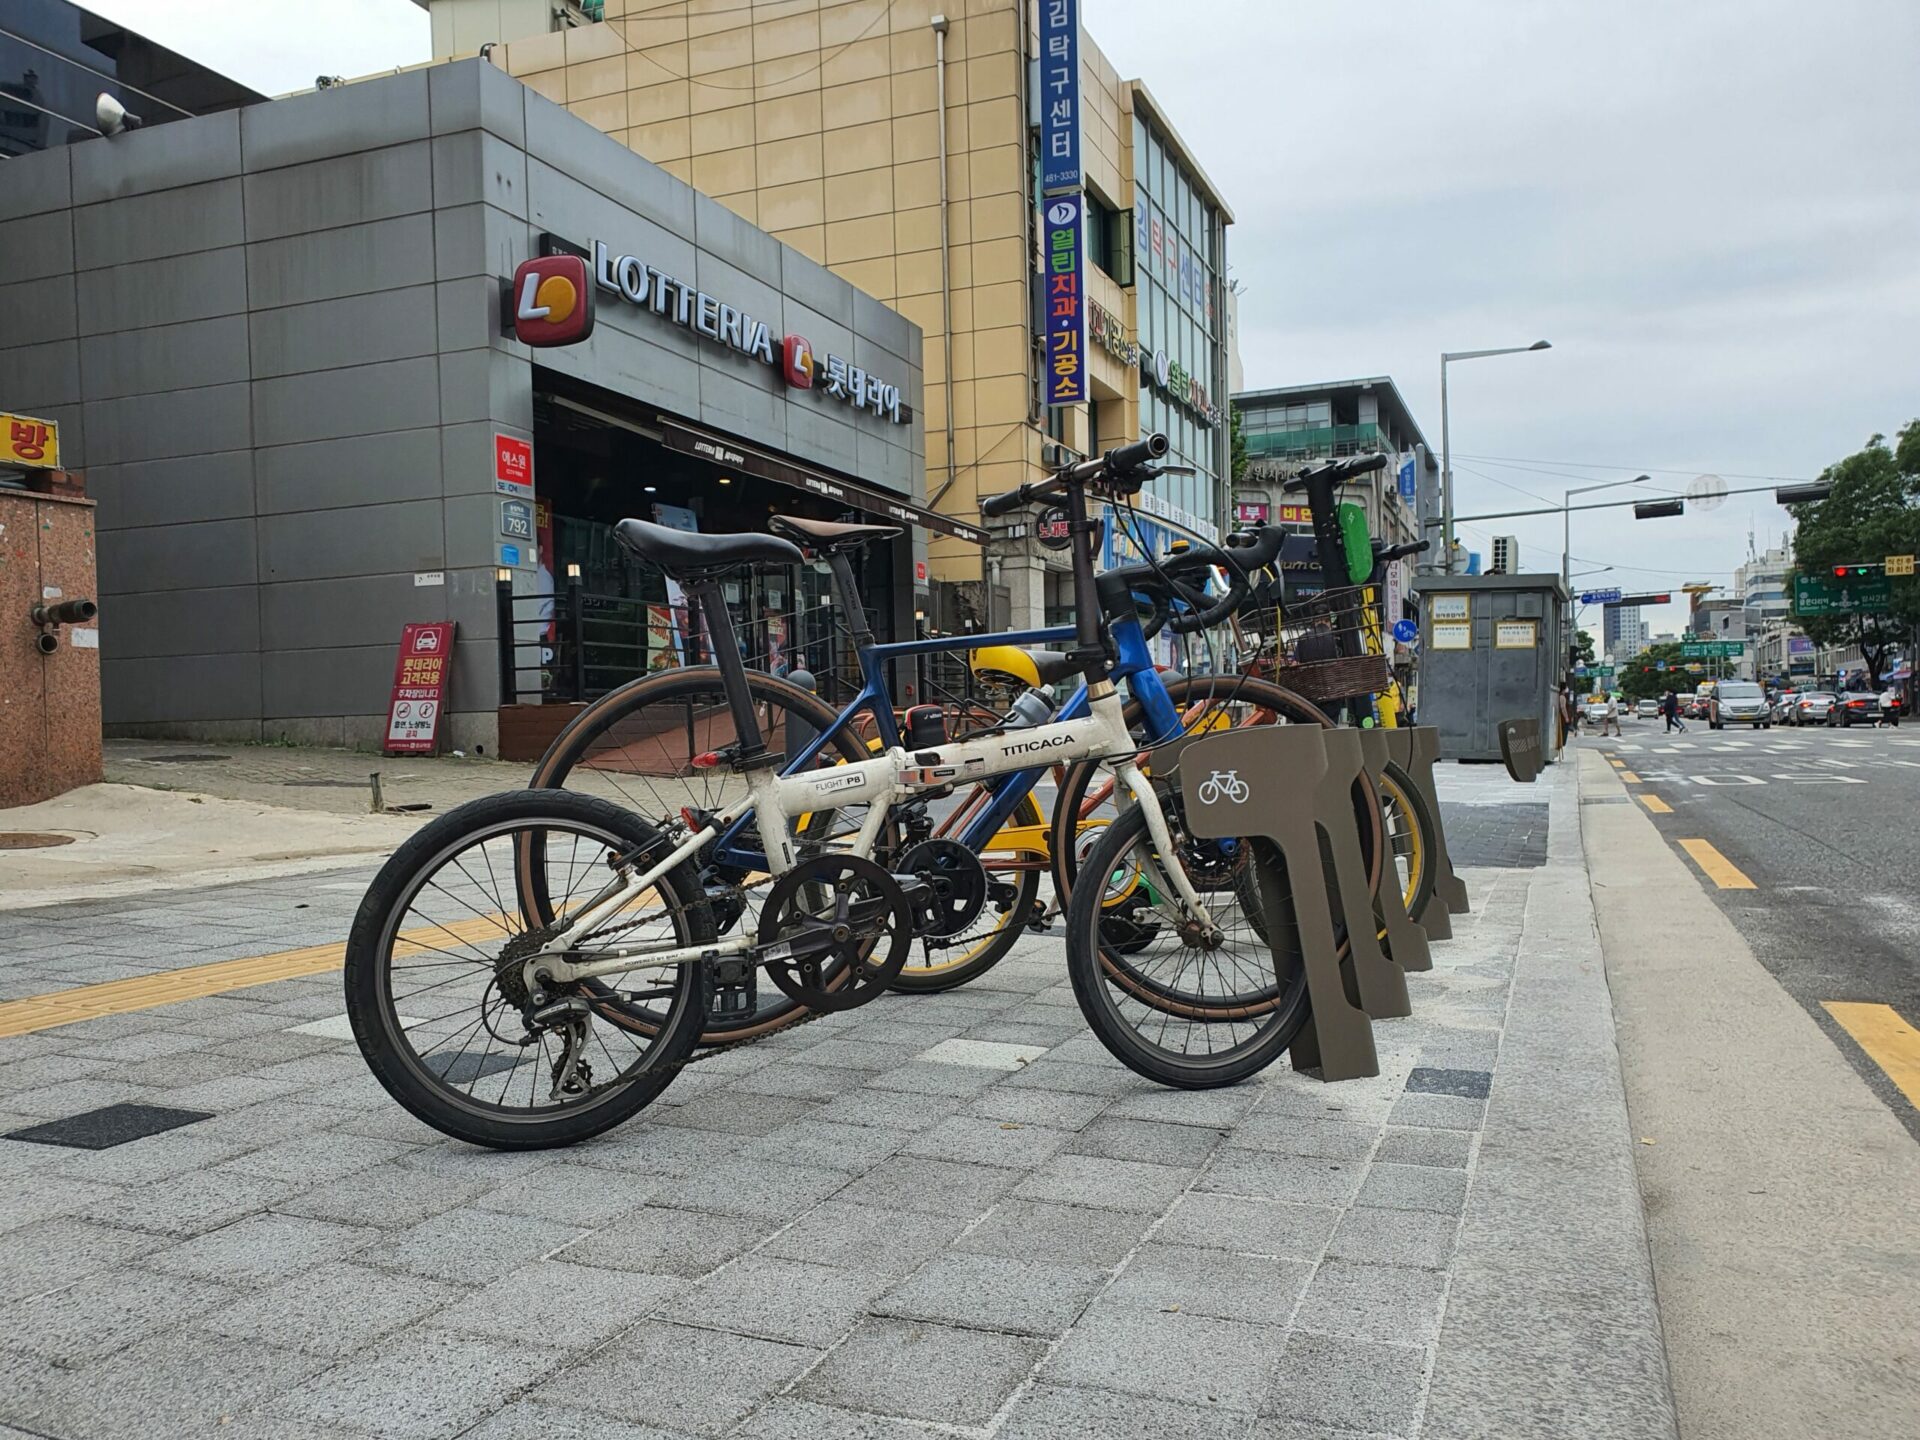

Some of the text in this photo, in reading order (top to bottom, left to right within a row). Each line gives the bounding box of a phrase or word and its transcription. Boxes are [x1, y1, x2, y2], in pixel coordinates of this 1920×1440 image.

[1047, 1, 1072, 159] 김탁구센터
[590, 239, 774, 365] LOTTERIA
[824, 352, 902, 425] 롯데리아
[11, 421, 49, 460] 방
[501, 450, 527, 470] 에스원
[508, 517, 528, 534] 792
[403, 657, 443, 671] 롯데리아
[400, 672, 441, 686] 고객전용
[398, 688, 439, 699] 주차장입니다
[1001, 734, 1076, 758] TITICACA
[815, 776, 861, 791] FLIGHT P8
